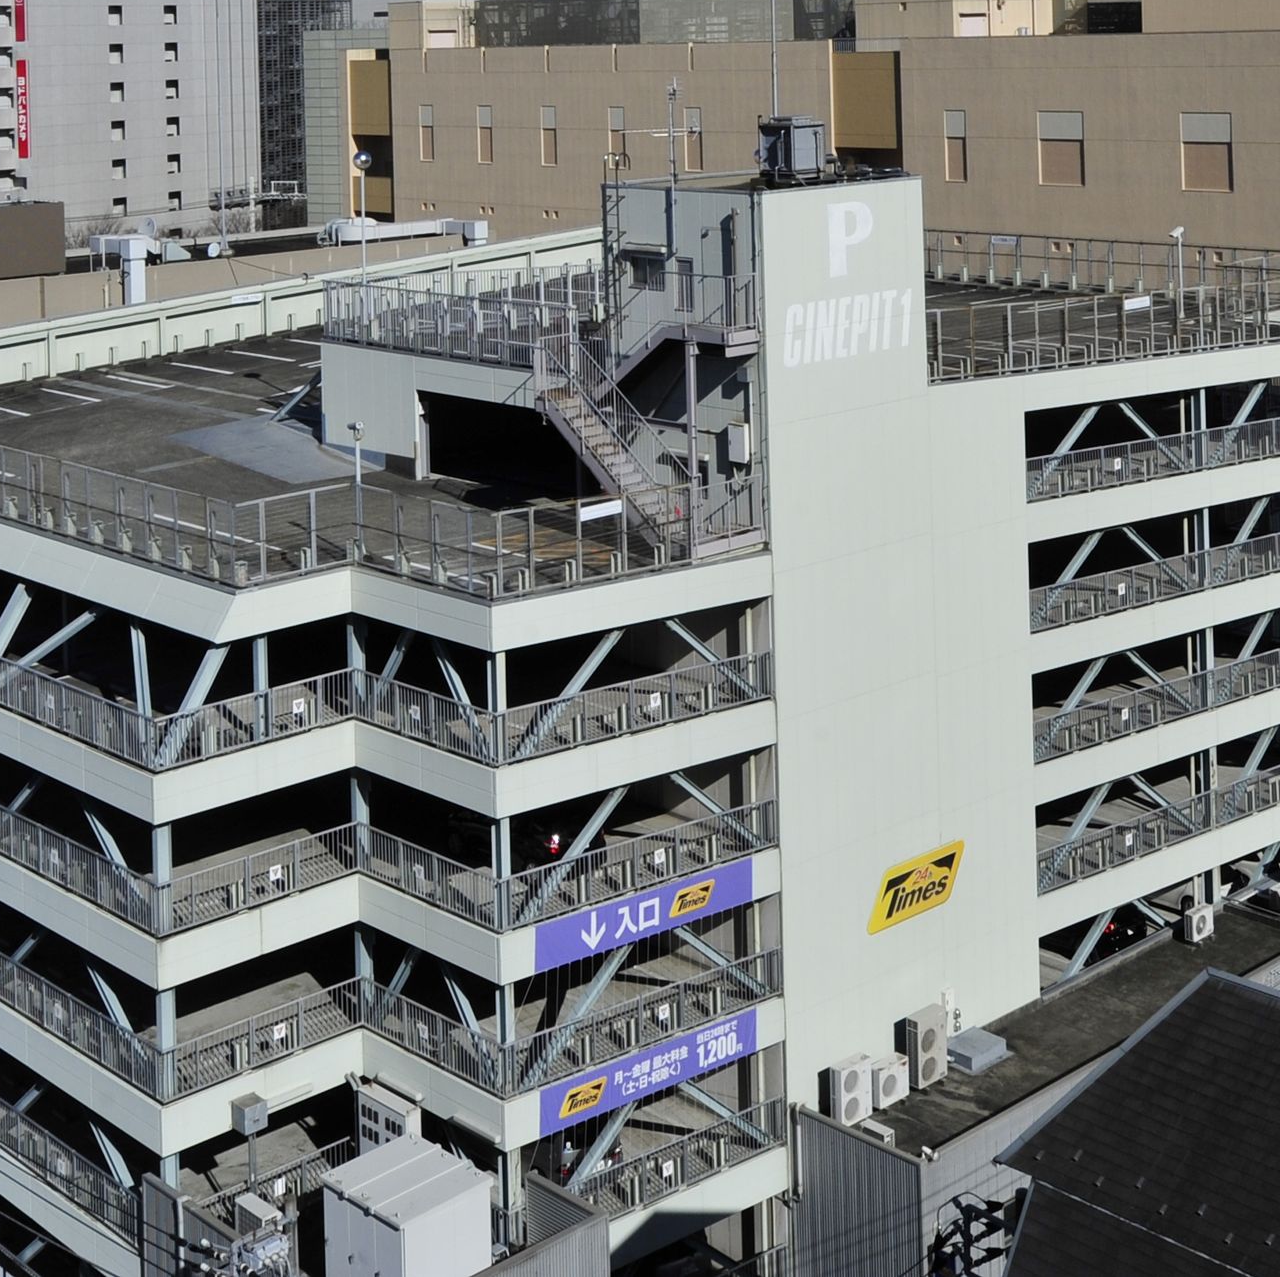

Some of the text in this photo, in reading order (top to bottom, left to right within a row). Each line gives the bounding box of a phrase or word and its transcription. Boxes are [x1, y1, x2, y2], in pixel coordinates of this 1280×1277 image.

[826, 201, 874, 278] P
[614, 896, 660, 940] 入口
[677, 890, 708, 913] Times
[885, 874, 949, 921] Times
